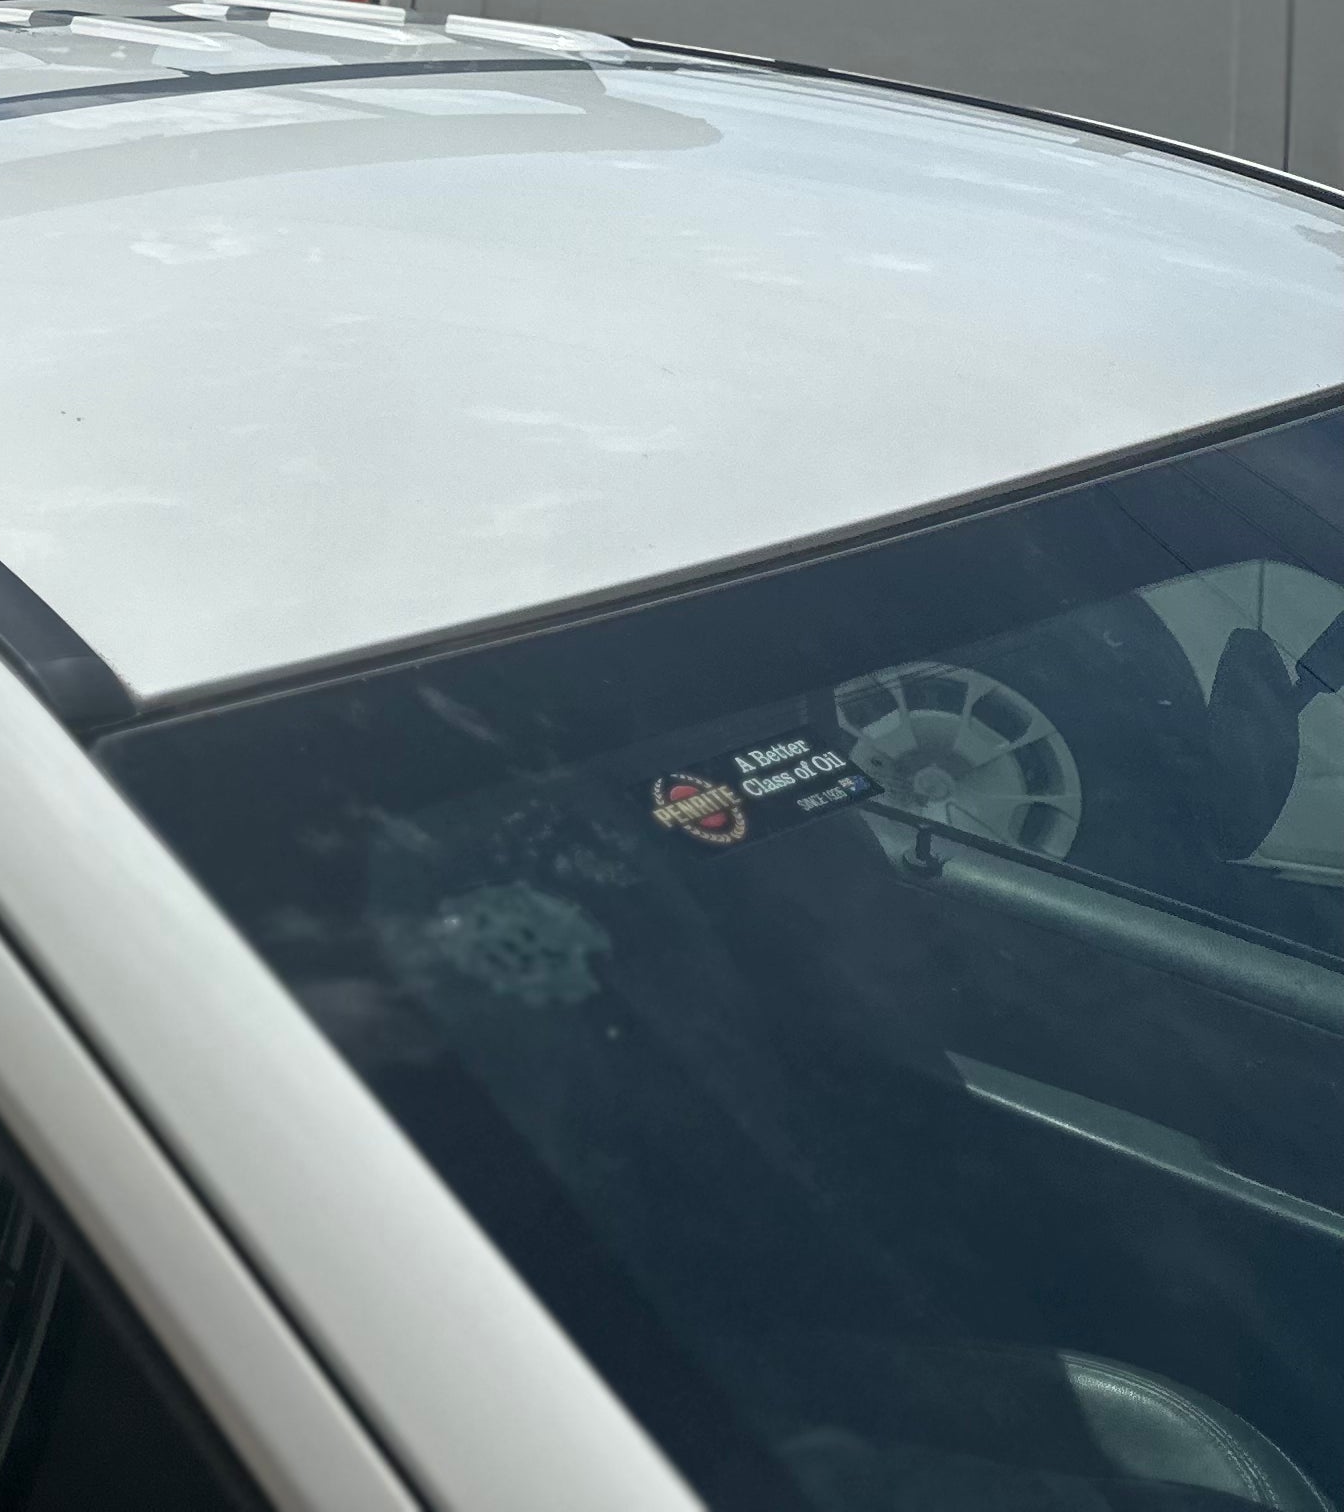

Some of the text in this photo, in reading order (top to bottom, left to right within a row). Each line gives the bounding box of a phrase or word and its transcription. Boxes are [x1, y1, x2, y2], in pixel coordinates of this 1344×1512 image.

[735, 740, 810, 774] A Better
[743, 751, 846, 796] Class of Oil
[653, 785, 741, 828] PENRITE
[797, 791, 829, 811] SINCE
